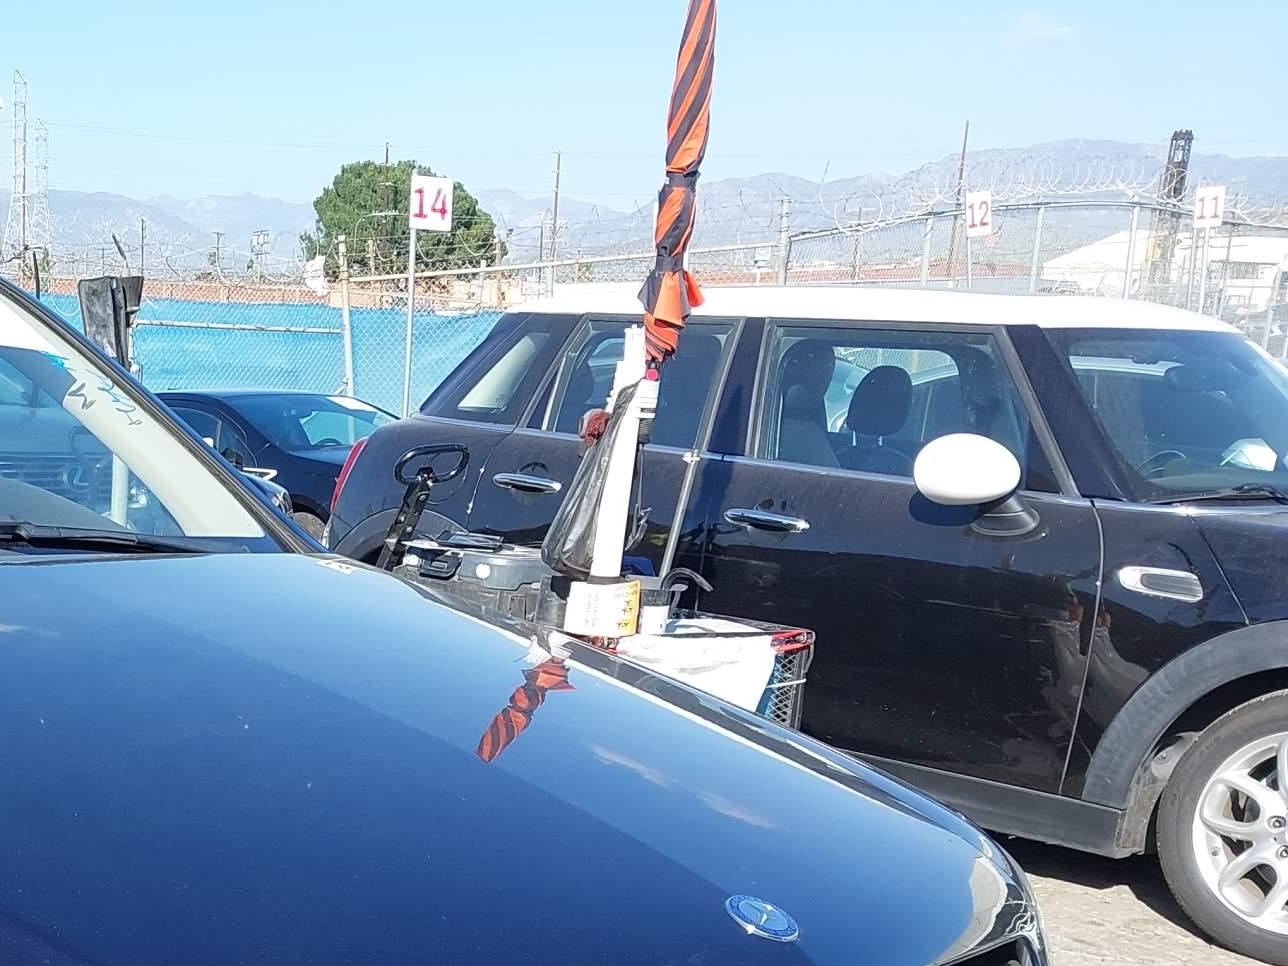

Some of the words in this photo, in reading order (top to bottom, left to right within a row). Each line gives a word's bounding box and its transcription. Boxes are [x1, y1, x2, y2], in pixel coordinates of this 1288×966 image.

[413, 187, 448, 220] 14
[968, 200, 990, 229] 12
[1196, 195, 1220, 220] 11
